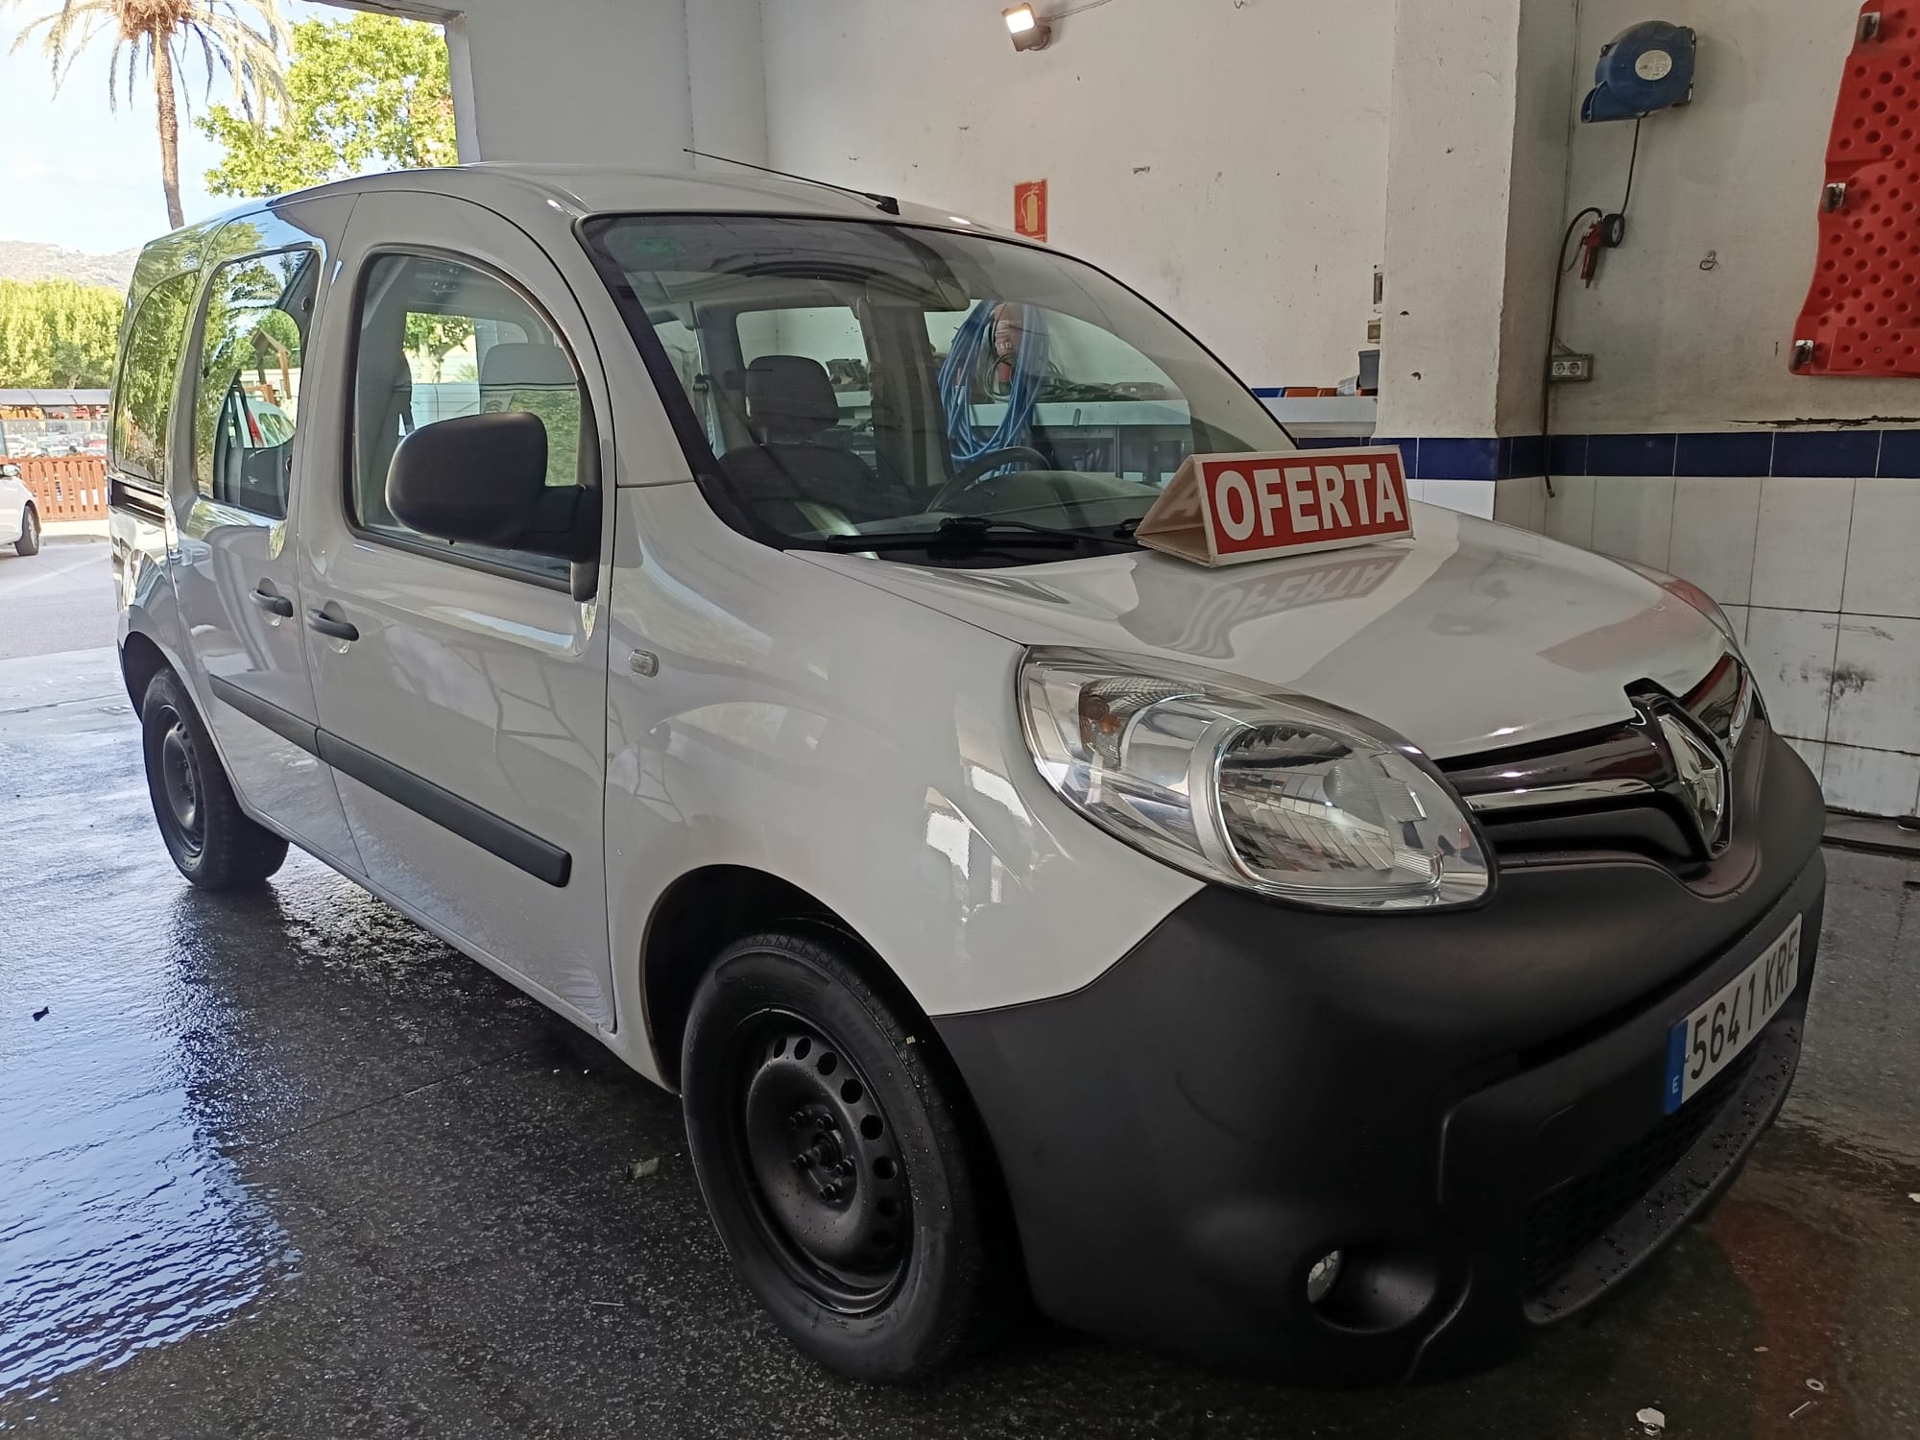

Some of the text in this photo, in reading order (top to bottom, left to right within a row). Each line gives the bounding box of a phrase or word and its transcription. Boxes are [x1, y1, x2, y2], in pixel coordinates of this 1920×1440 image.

[1214, 462, 1404, 541] OFERTA
[1672, 927, 1798, 1094] E 5641 KRF
